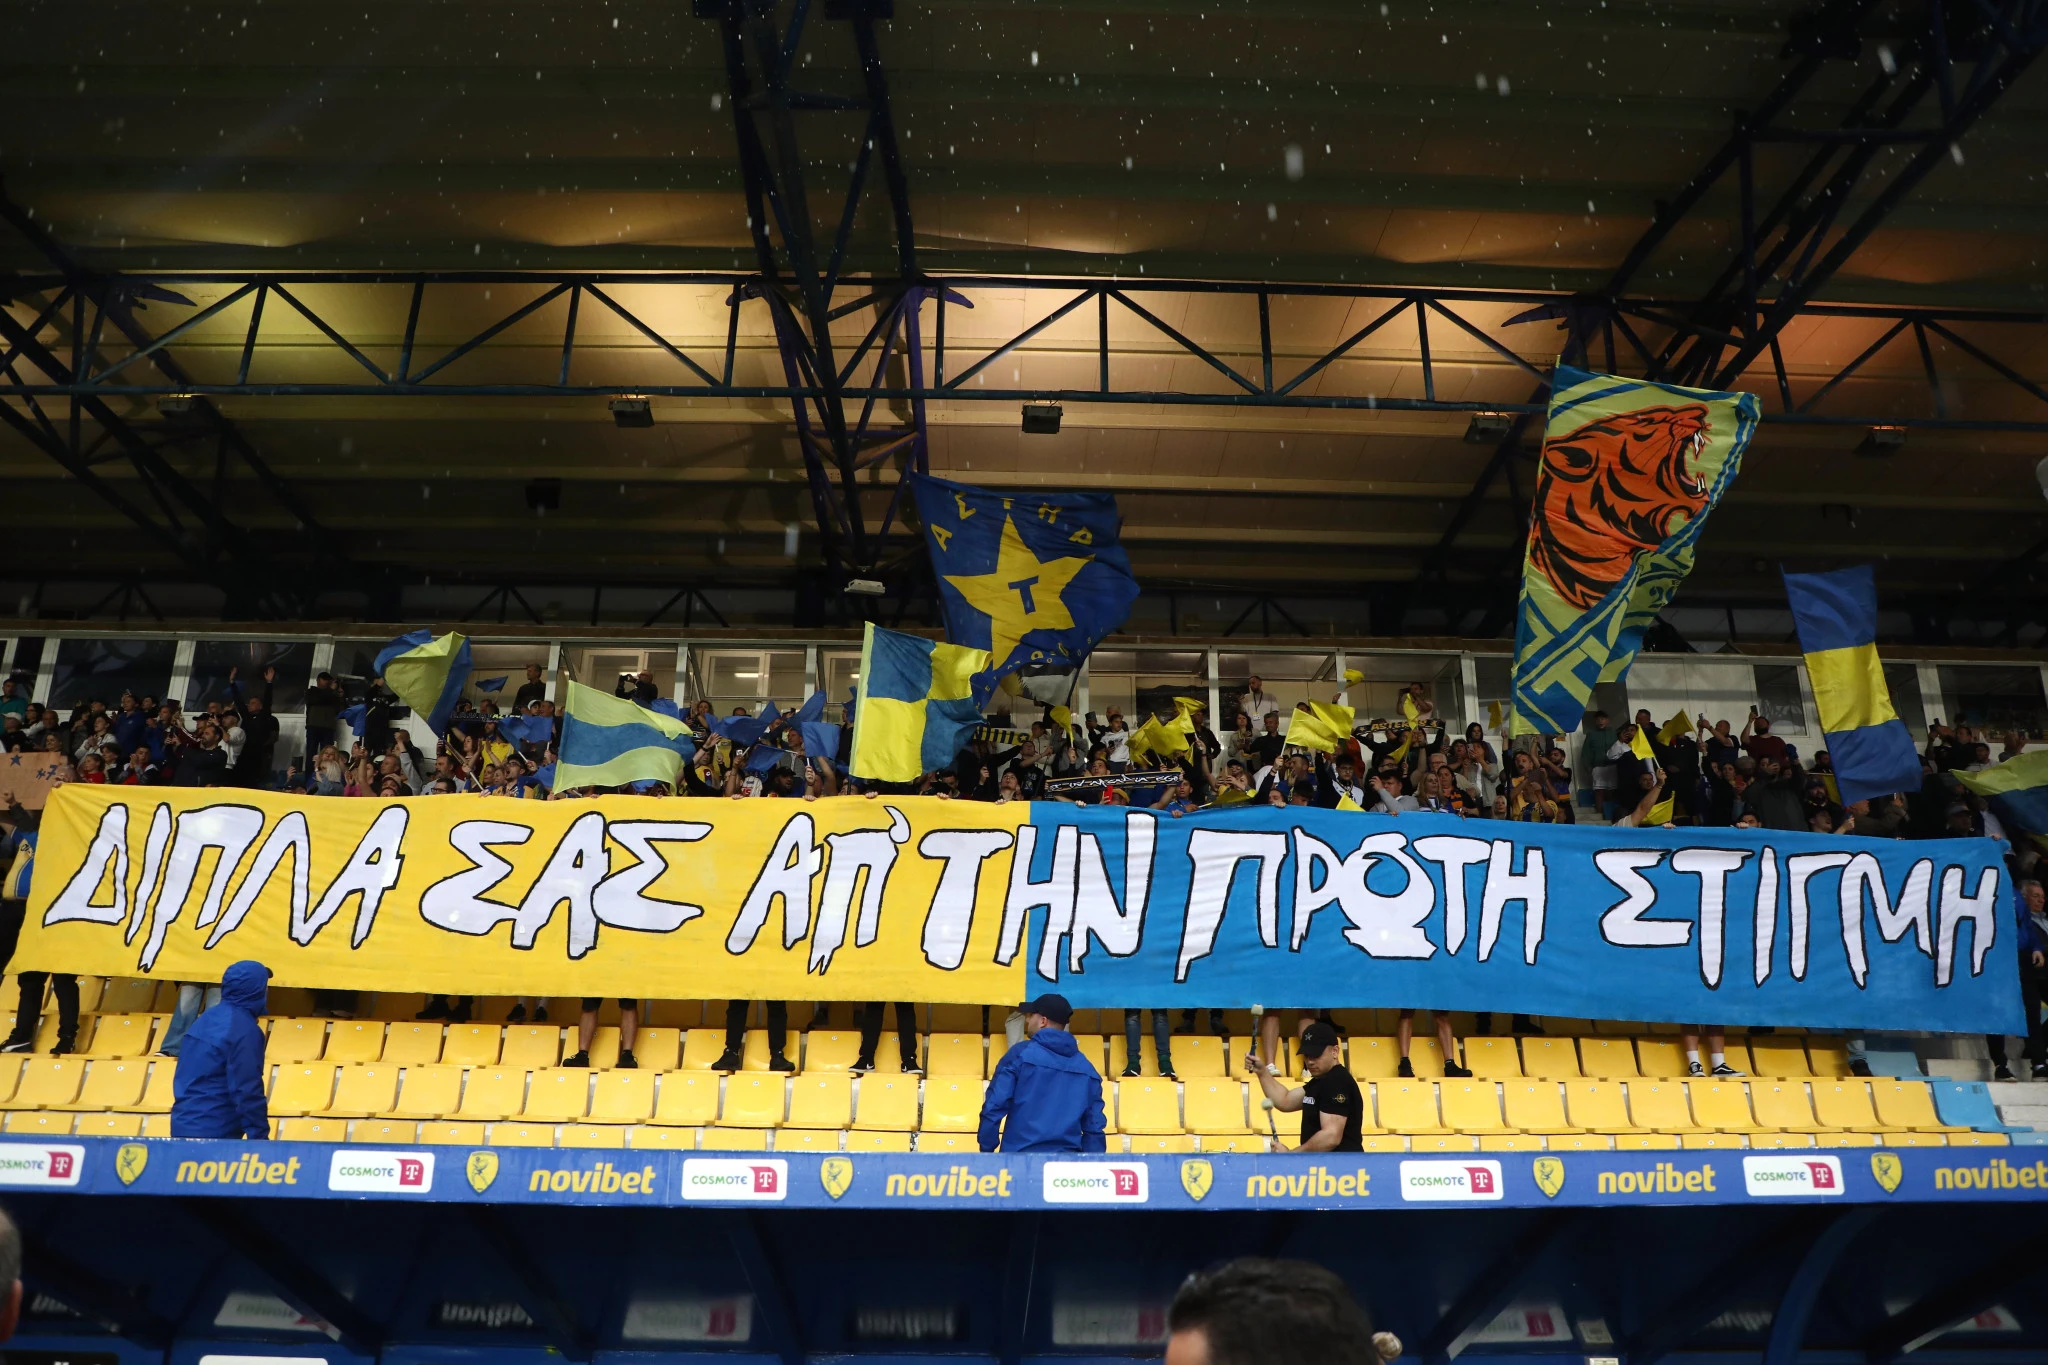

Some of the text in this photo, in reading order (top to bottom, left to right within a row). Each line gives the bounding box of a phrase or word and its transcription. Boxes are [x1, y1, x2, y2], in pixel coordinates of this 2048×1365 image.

[1371, 720, 1427, 731] ASTERS
[43, 803, 409, 972] ΔΙΠΛΑ
[419, 811, 714, 960] ΣΑΣ
[918, 811, 1158, 982] ΤΗΝ
[1174, 825, 1546, 982] ΠΡΩΤΗ
[1594, 845, 2000, 990] ΣΤΙΓΜΗ
[176, 1153, 301, 1184] novibet
[339, 1167, 395, 1177] COSMOTE
[529, 1162, 655, 1194] novibet
[691, 1175, 748, 1185] COSMOTE
[886, 1166, 1012, 1197] novibet
[1052, 1178, 1109, 1188] COSMOTE
[1246, 1167, 1370, 1197] novibet
[1410, 1176, 1465, 1186] COSMOTE
[1598, 1163, 1715, 1193] novibet
[1753, 1172, 1807, 1182] COSMOTE
[1934, 1158, 2048, 1189] novibet
